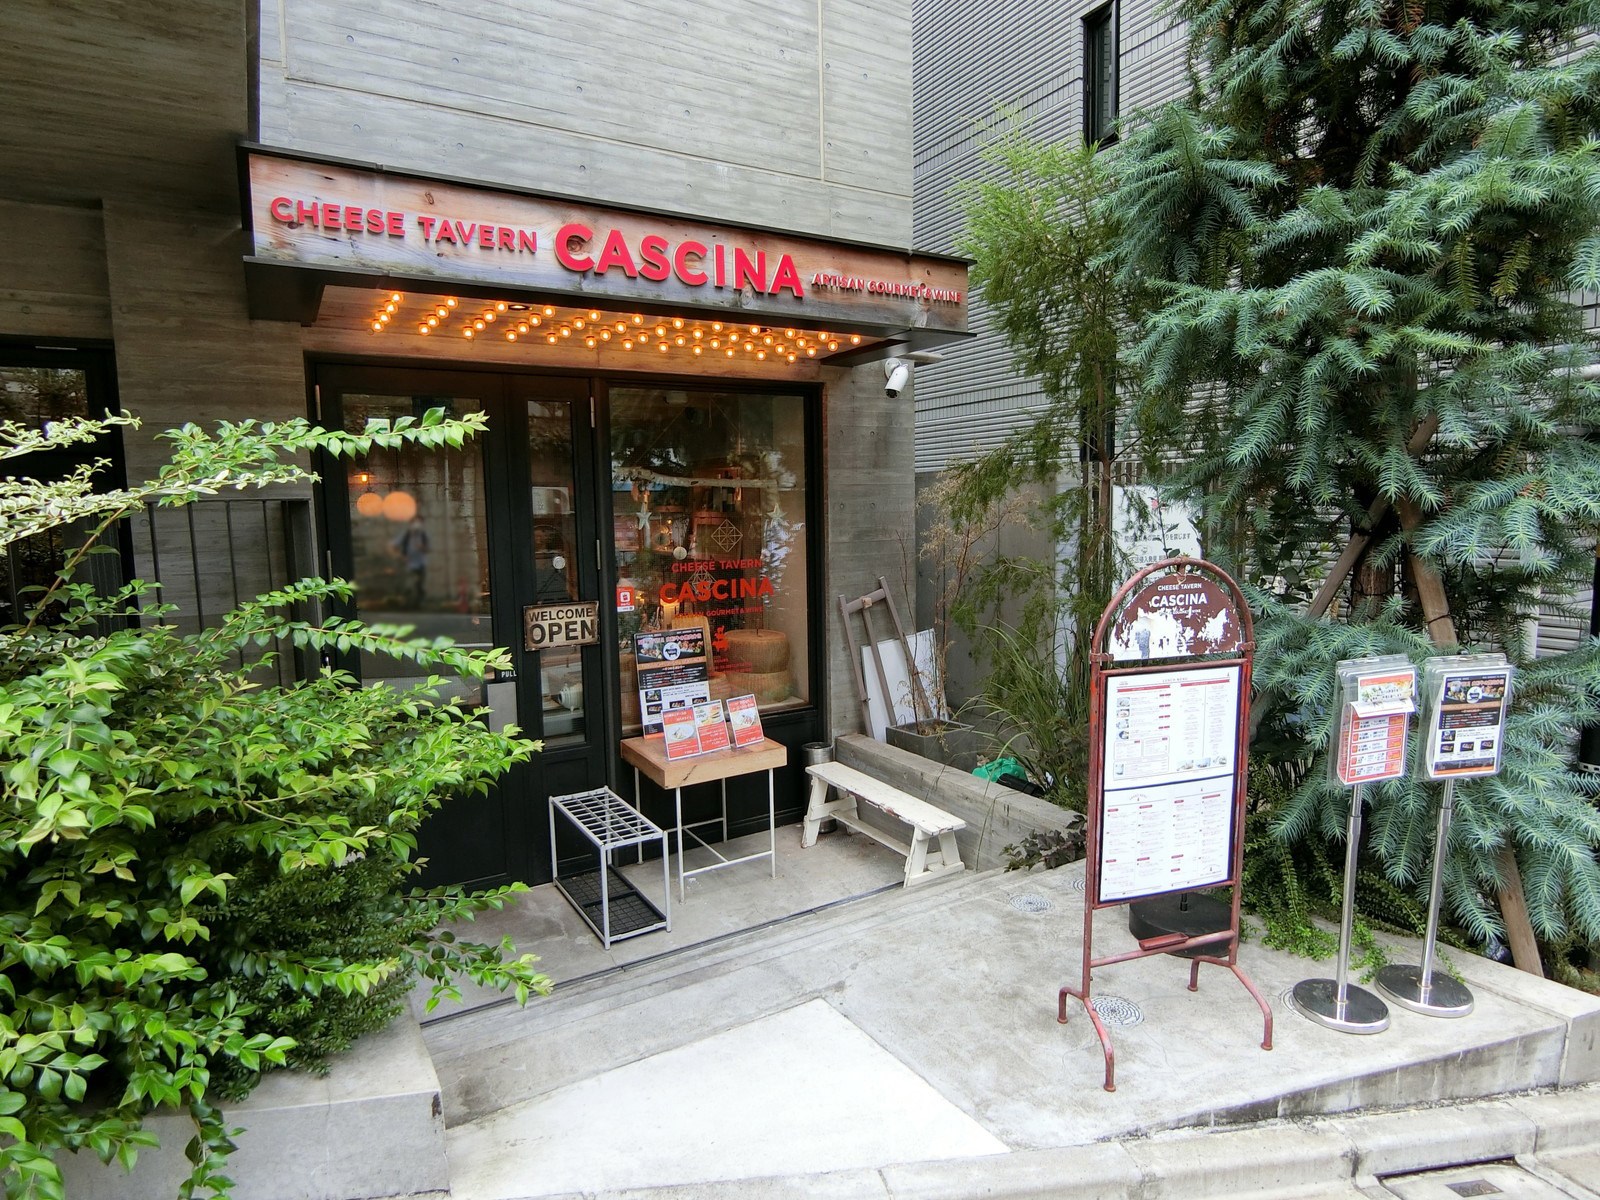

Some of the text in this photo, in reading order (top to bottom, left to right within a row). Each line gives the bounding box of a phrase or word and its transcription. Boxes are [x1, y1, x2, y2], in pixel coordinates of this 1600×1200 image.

[270, 197, 805, 298] CHEESE TAVERN CASCINA
[812, 273, 865, 290] ARTISAN
[868, 280, 923, 298] GOURMET
[932, 289, 962, 303] WINE
[671, 558, 763, 573] CHEESE TAVERN
[659, 576, 775, 604] CASCINA
[1152, 592, 1208, 607] CASCINA
[530, 608, 594, 622] WELCOME
[706, 607, 739, 617] GOURMET
[530, 619, 596, 644] OPEN
[500, 670, 517, 678] PULL
